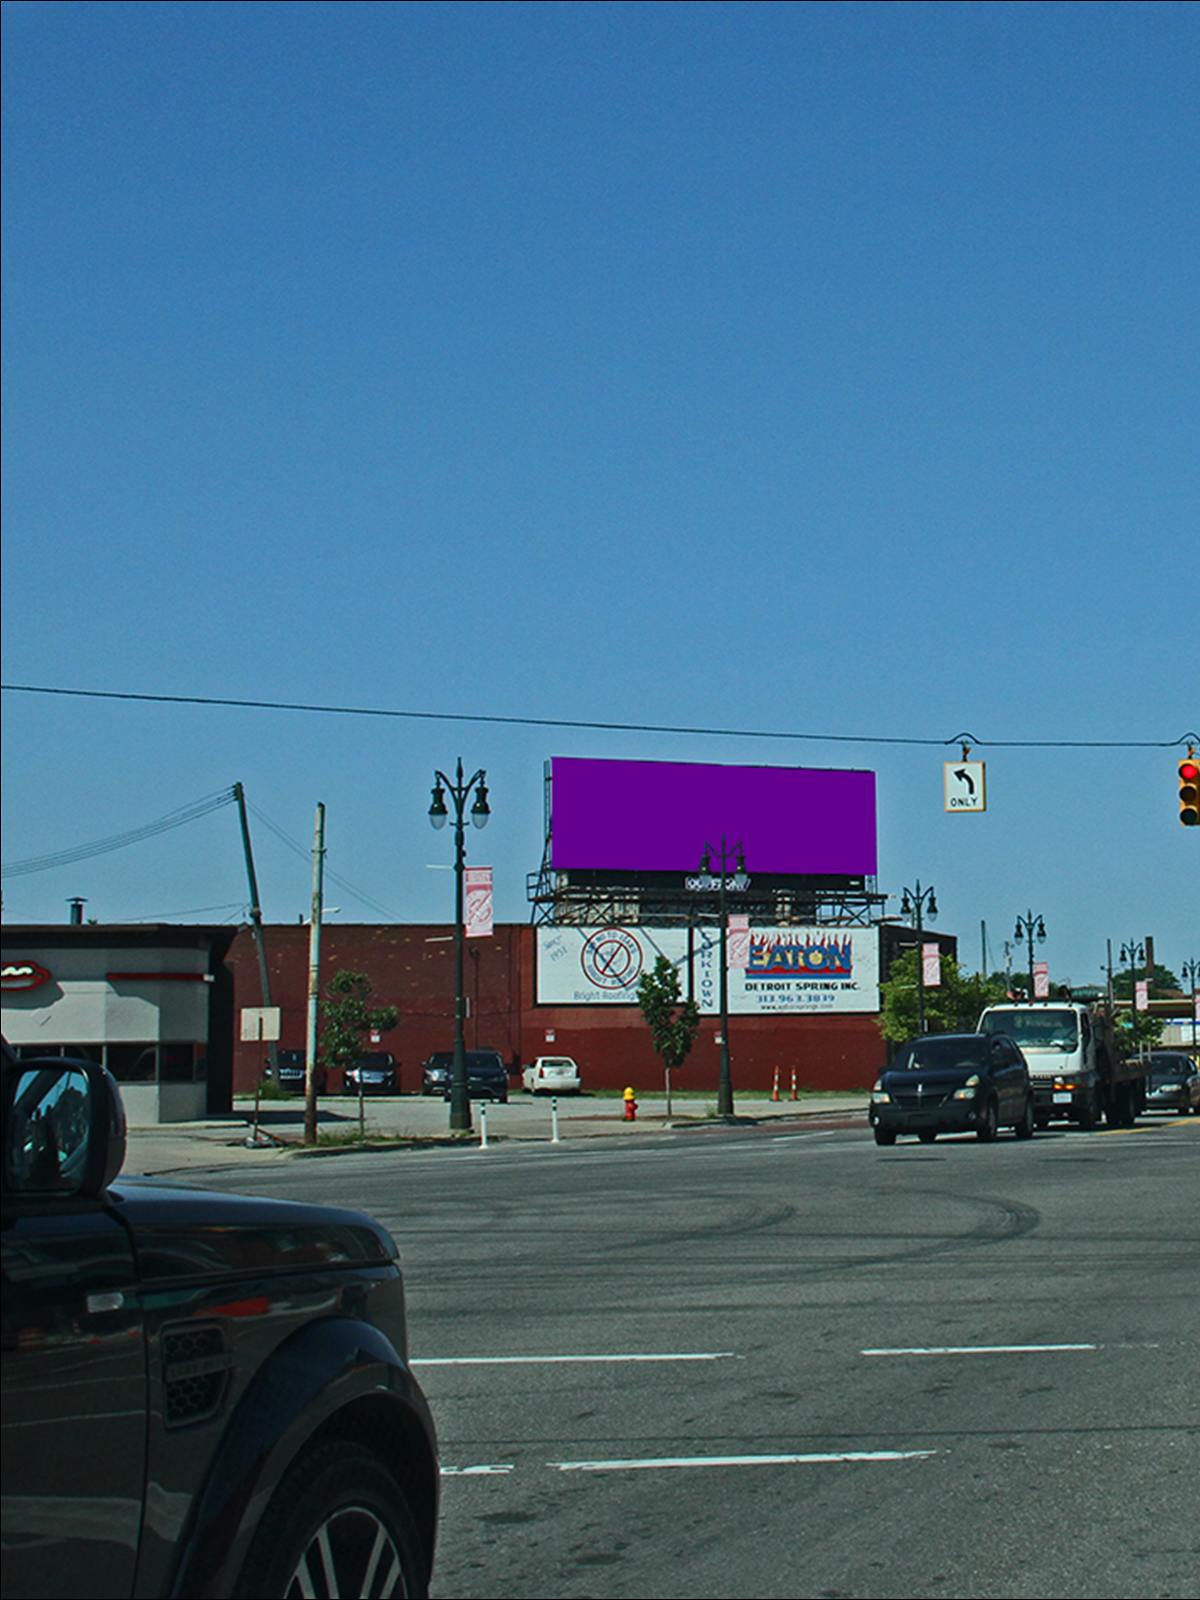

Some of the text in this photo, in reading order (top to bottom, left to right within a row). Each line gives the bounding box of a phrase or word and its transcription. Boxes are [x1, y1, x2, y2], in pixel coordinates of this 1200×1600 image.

[950, 797, 978, 807] ONLY
[749, 944, 852, 971] EATON
[745, 981, 861, 991] DETROIT SPRING INC.
[574, 990, 635, 1001] Bright Roofing
